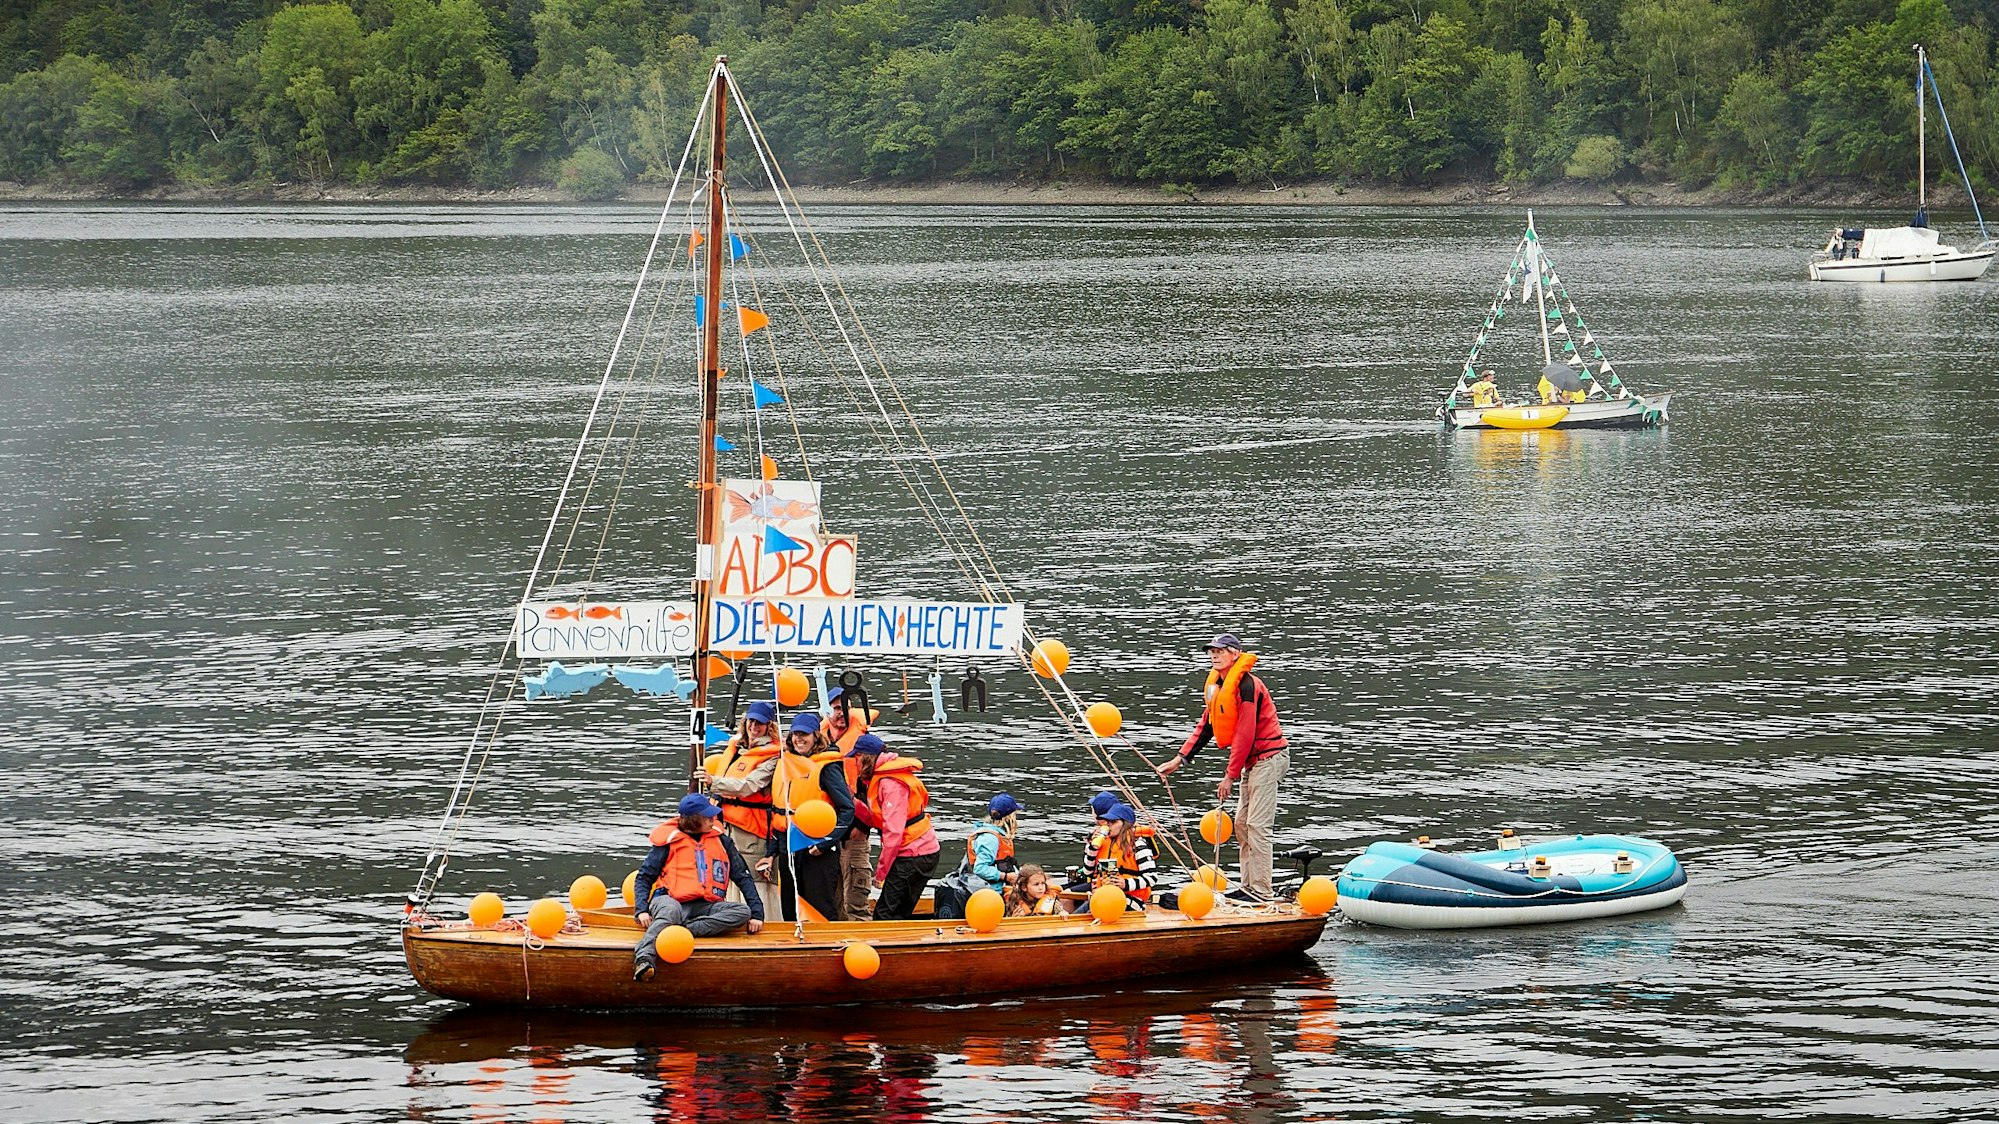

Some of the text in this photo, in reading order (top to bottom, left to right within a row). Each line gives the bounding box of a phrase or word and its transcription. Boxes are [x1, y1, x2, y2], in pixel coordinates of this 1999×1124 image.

[718, 534, 855, 598] ADBC
[519, 605, 691, 654] Pannenhilfe
[712, 600, 1008, 650] DIE BLAUEN HECHTE
[692, 710, 706, 741] 4
